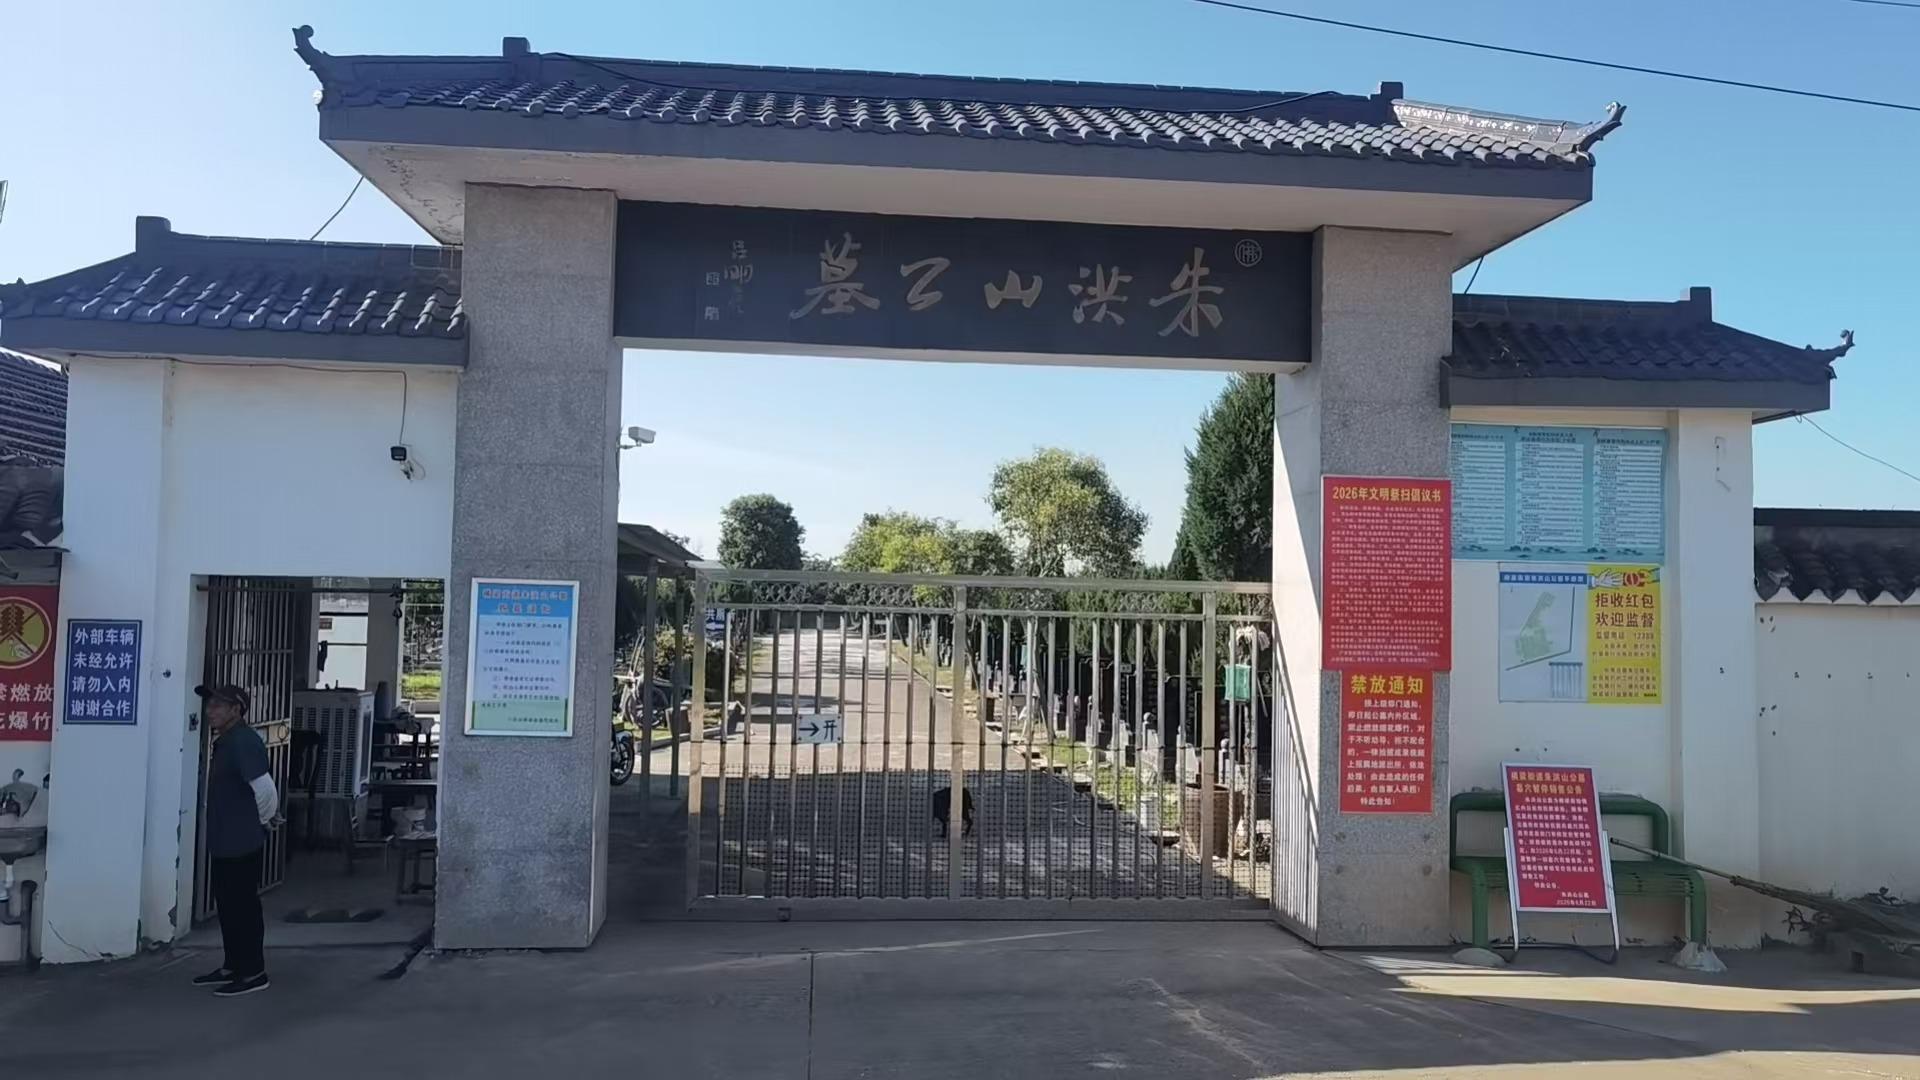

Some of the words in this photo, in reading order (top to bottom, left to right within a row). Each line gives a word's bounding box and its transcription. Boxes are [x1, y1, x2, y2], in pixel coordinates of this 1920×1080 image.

[1332, 486, 1441, 502] 2026年文明祭扫倡议书
[1595, 592, 1655, 609] 拒收红包
[1595, 611, 1655, 628] 欢迎监督
[74, 628, 135, 645] 外部车辆
[73, 652, 134, 670] 未经允许
[72, 676, 131, 694] 请勿入内
[1350, 674, 1424, 694] 禁放通知
[71, 700, 131, 718] 谢谢合作
[0, 711, 52, 730] 爆竹
[823, 720, 838, 741] 开
